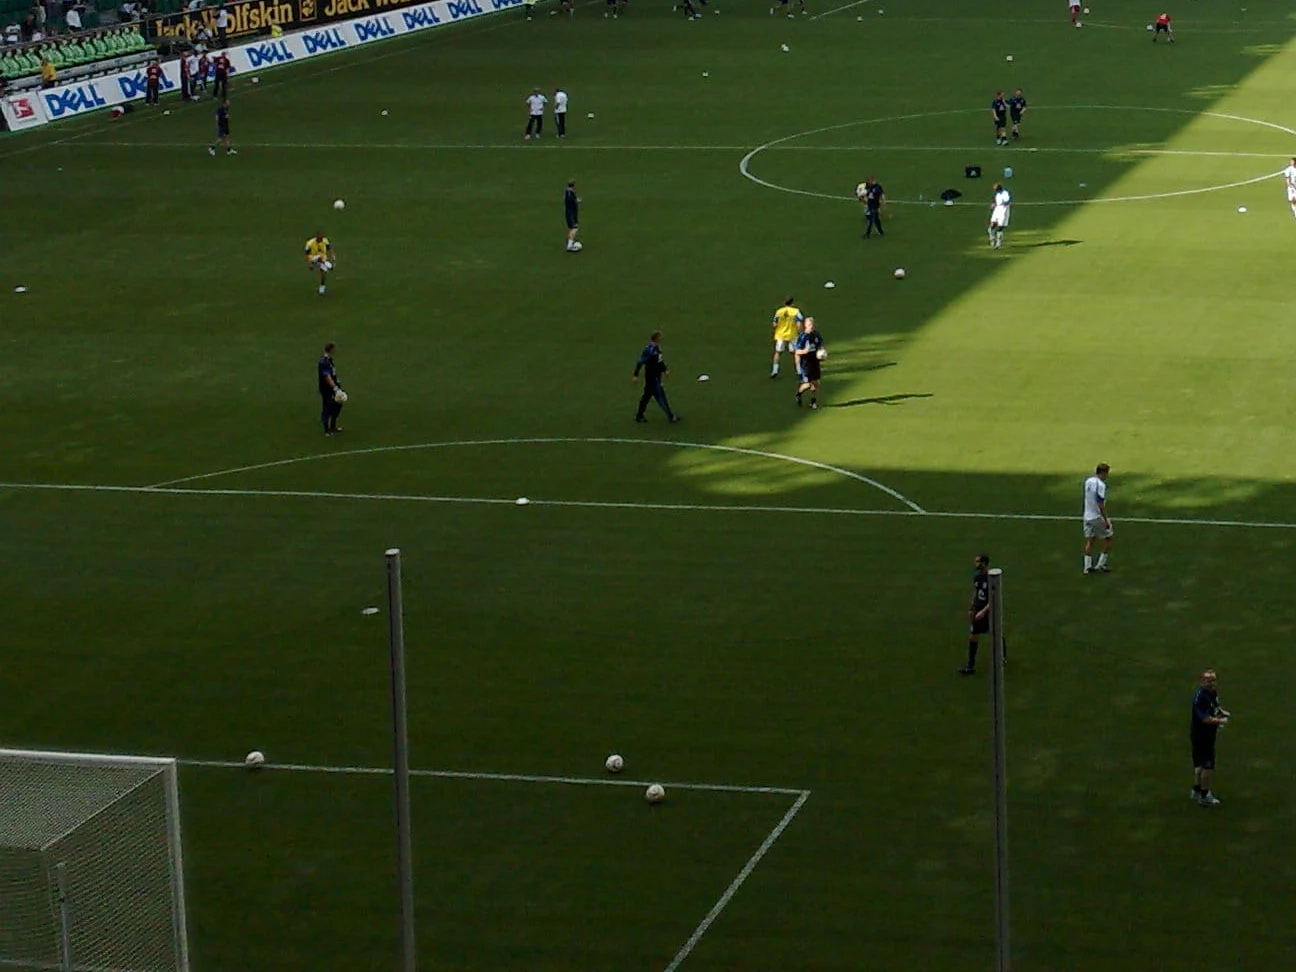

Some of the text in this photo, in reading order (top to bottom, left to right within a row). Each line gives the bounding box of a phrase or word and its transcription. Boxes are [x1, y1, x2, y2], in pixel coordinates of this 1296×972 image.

[354, 16, 395, 41] DELL
[402, 6, 440, 30] DELL
[246, 40, 294, 67] DELL
[301, 27, 346, 55] DELL
[45, 84, 106, 117] DELL
